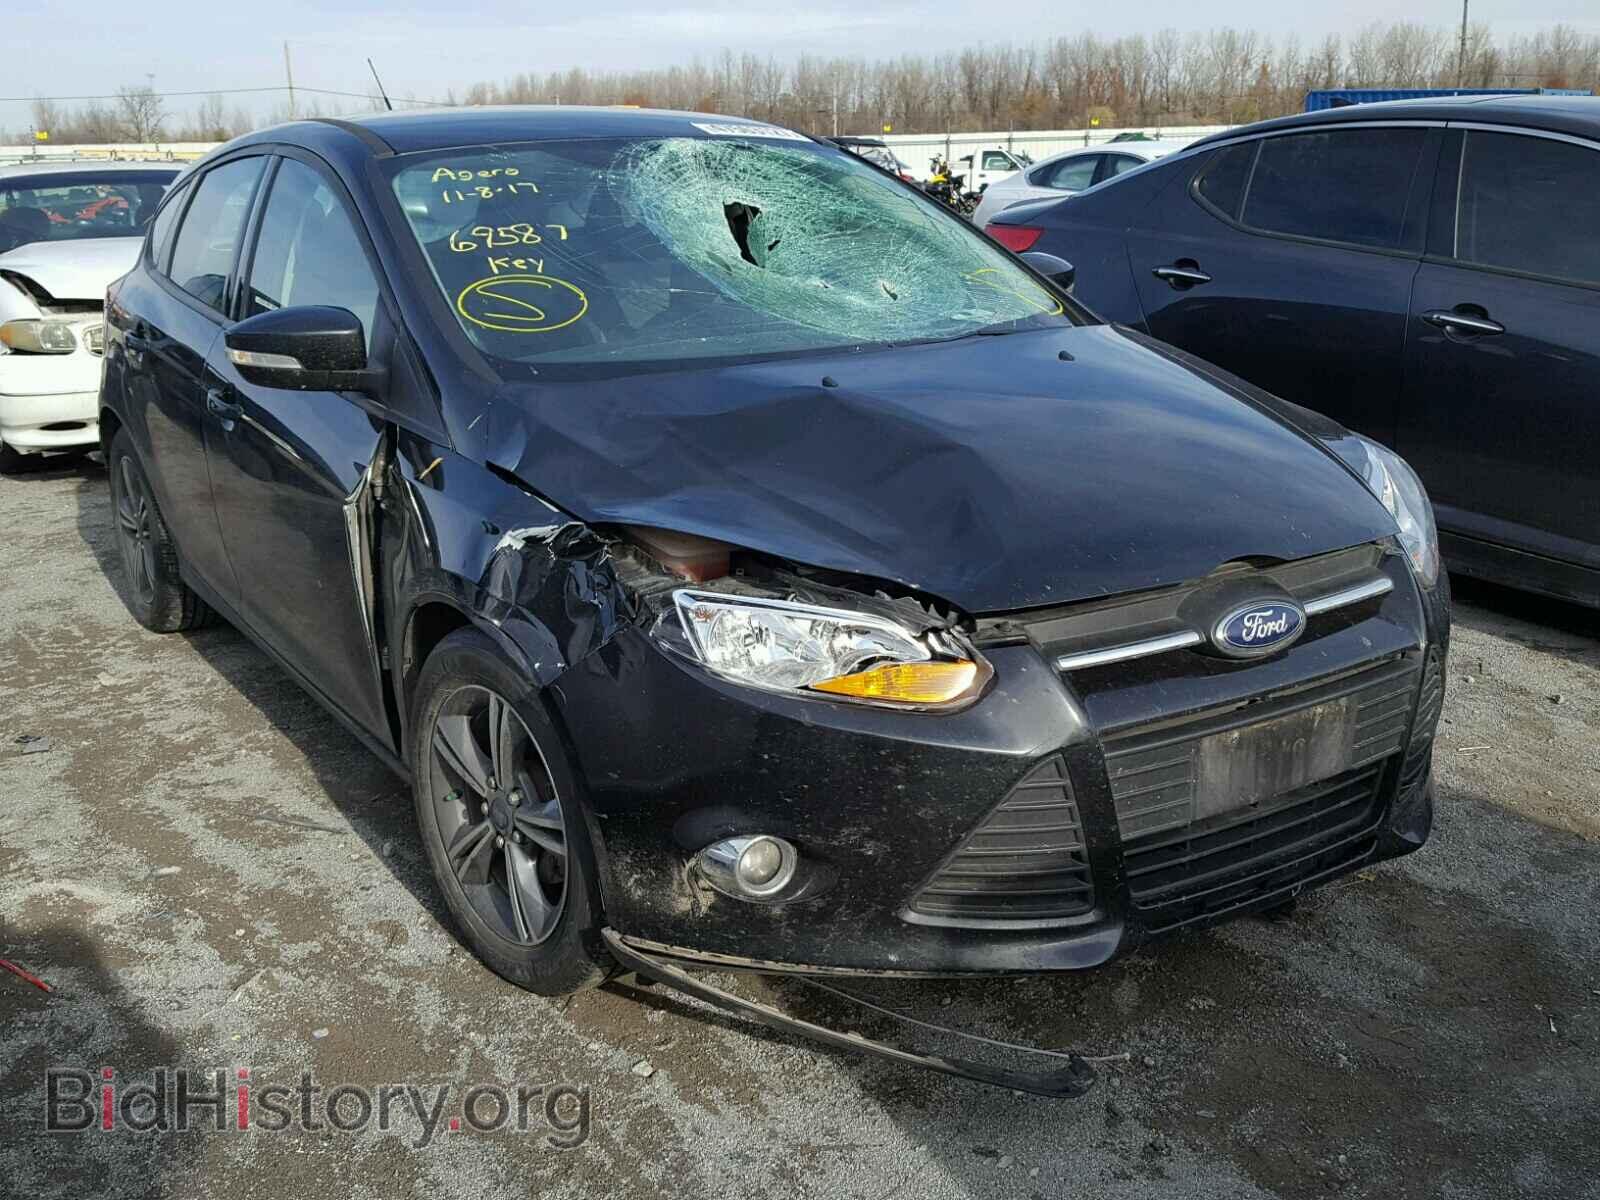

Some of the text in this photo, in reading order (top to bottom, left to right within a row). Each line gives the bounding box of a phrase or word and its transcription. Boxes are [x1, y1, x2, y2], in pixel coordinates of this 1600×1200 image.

[450, 223, 568, 252] 69587
[487, 256, 544, 275] Key
[1242, 609, 1288, 642] Ford
